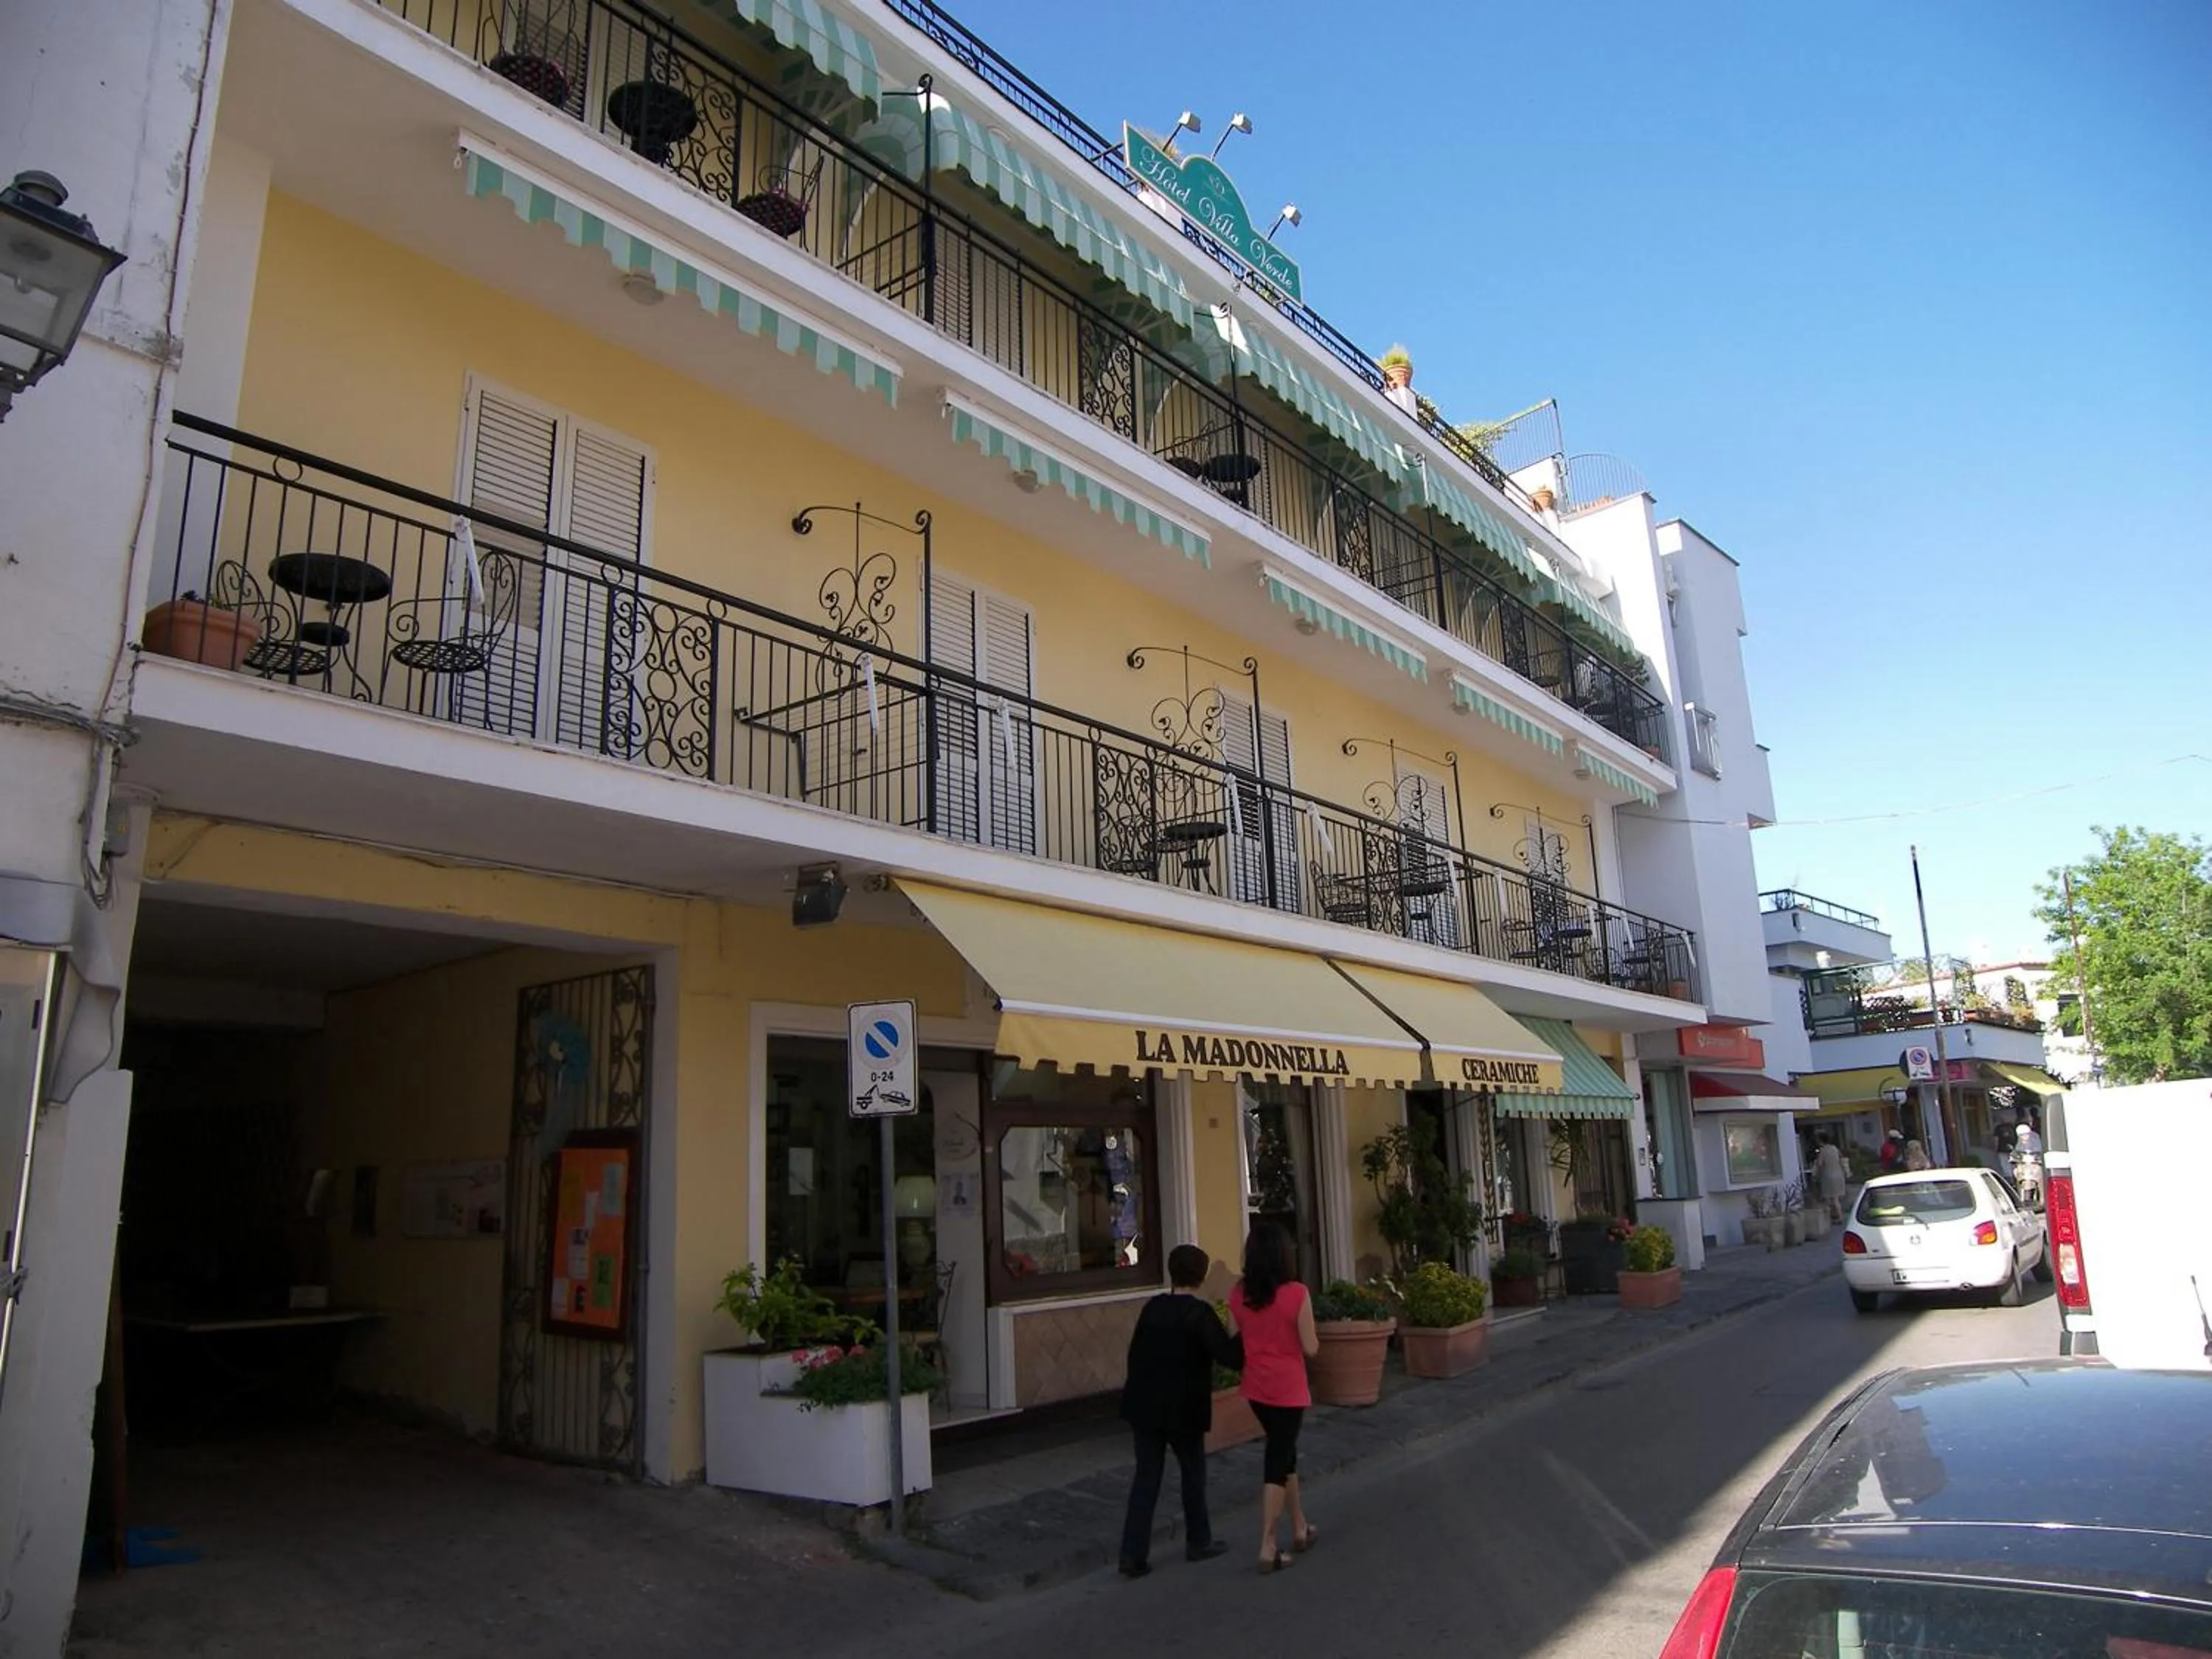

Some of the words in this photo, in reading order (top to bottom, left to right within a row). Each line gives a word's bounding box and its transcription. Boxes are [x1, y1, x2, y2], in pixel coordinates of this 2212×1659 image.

[1139, 145, 1192, 205] Hotel
[1198, 196, 1239, 247] Villa
[1250, 238, 1293, 288] Verde
[1135, 1030, 1176, 1063] LA
[1181, 1034, 1349, 1075] MADONNELLA
[871, 1071, 894, 1082] 0-24
[1461, 1058, 1539, 1084] CERAMICHE
